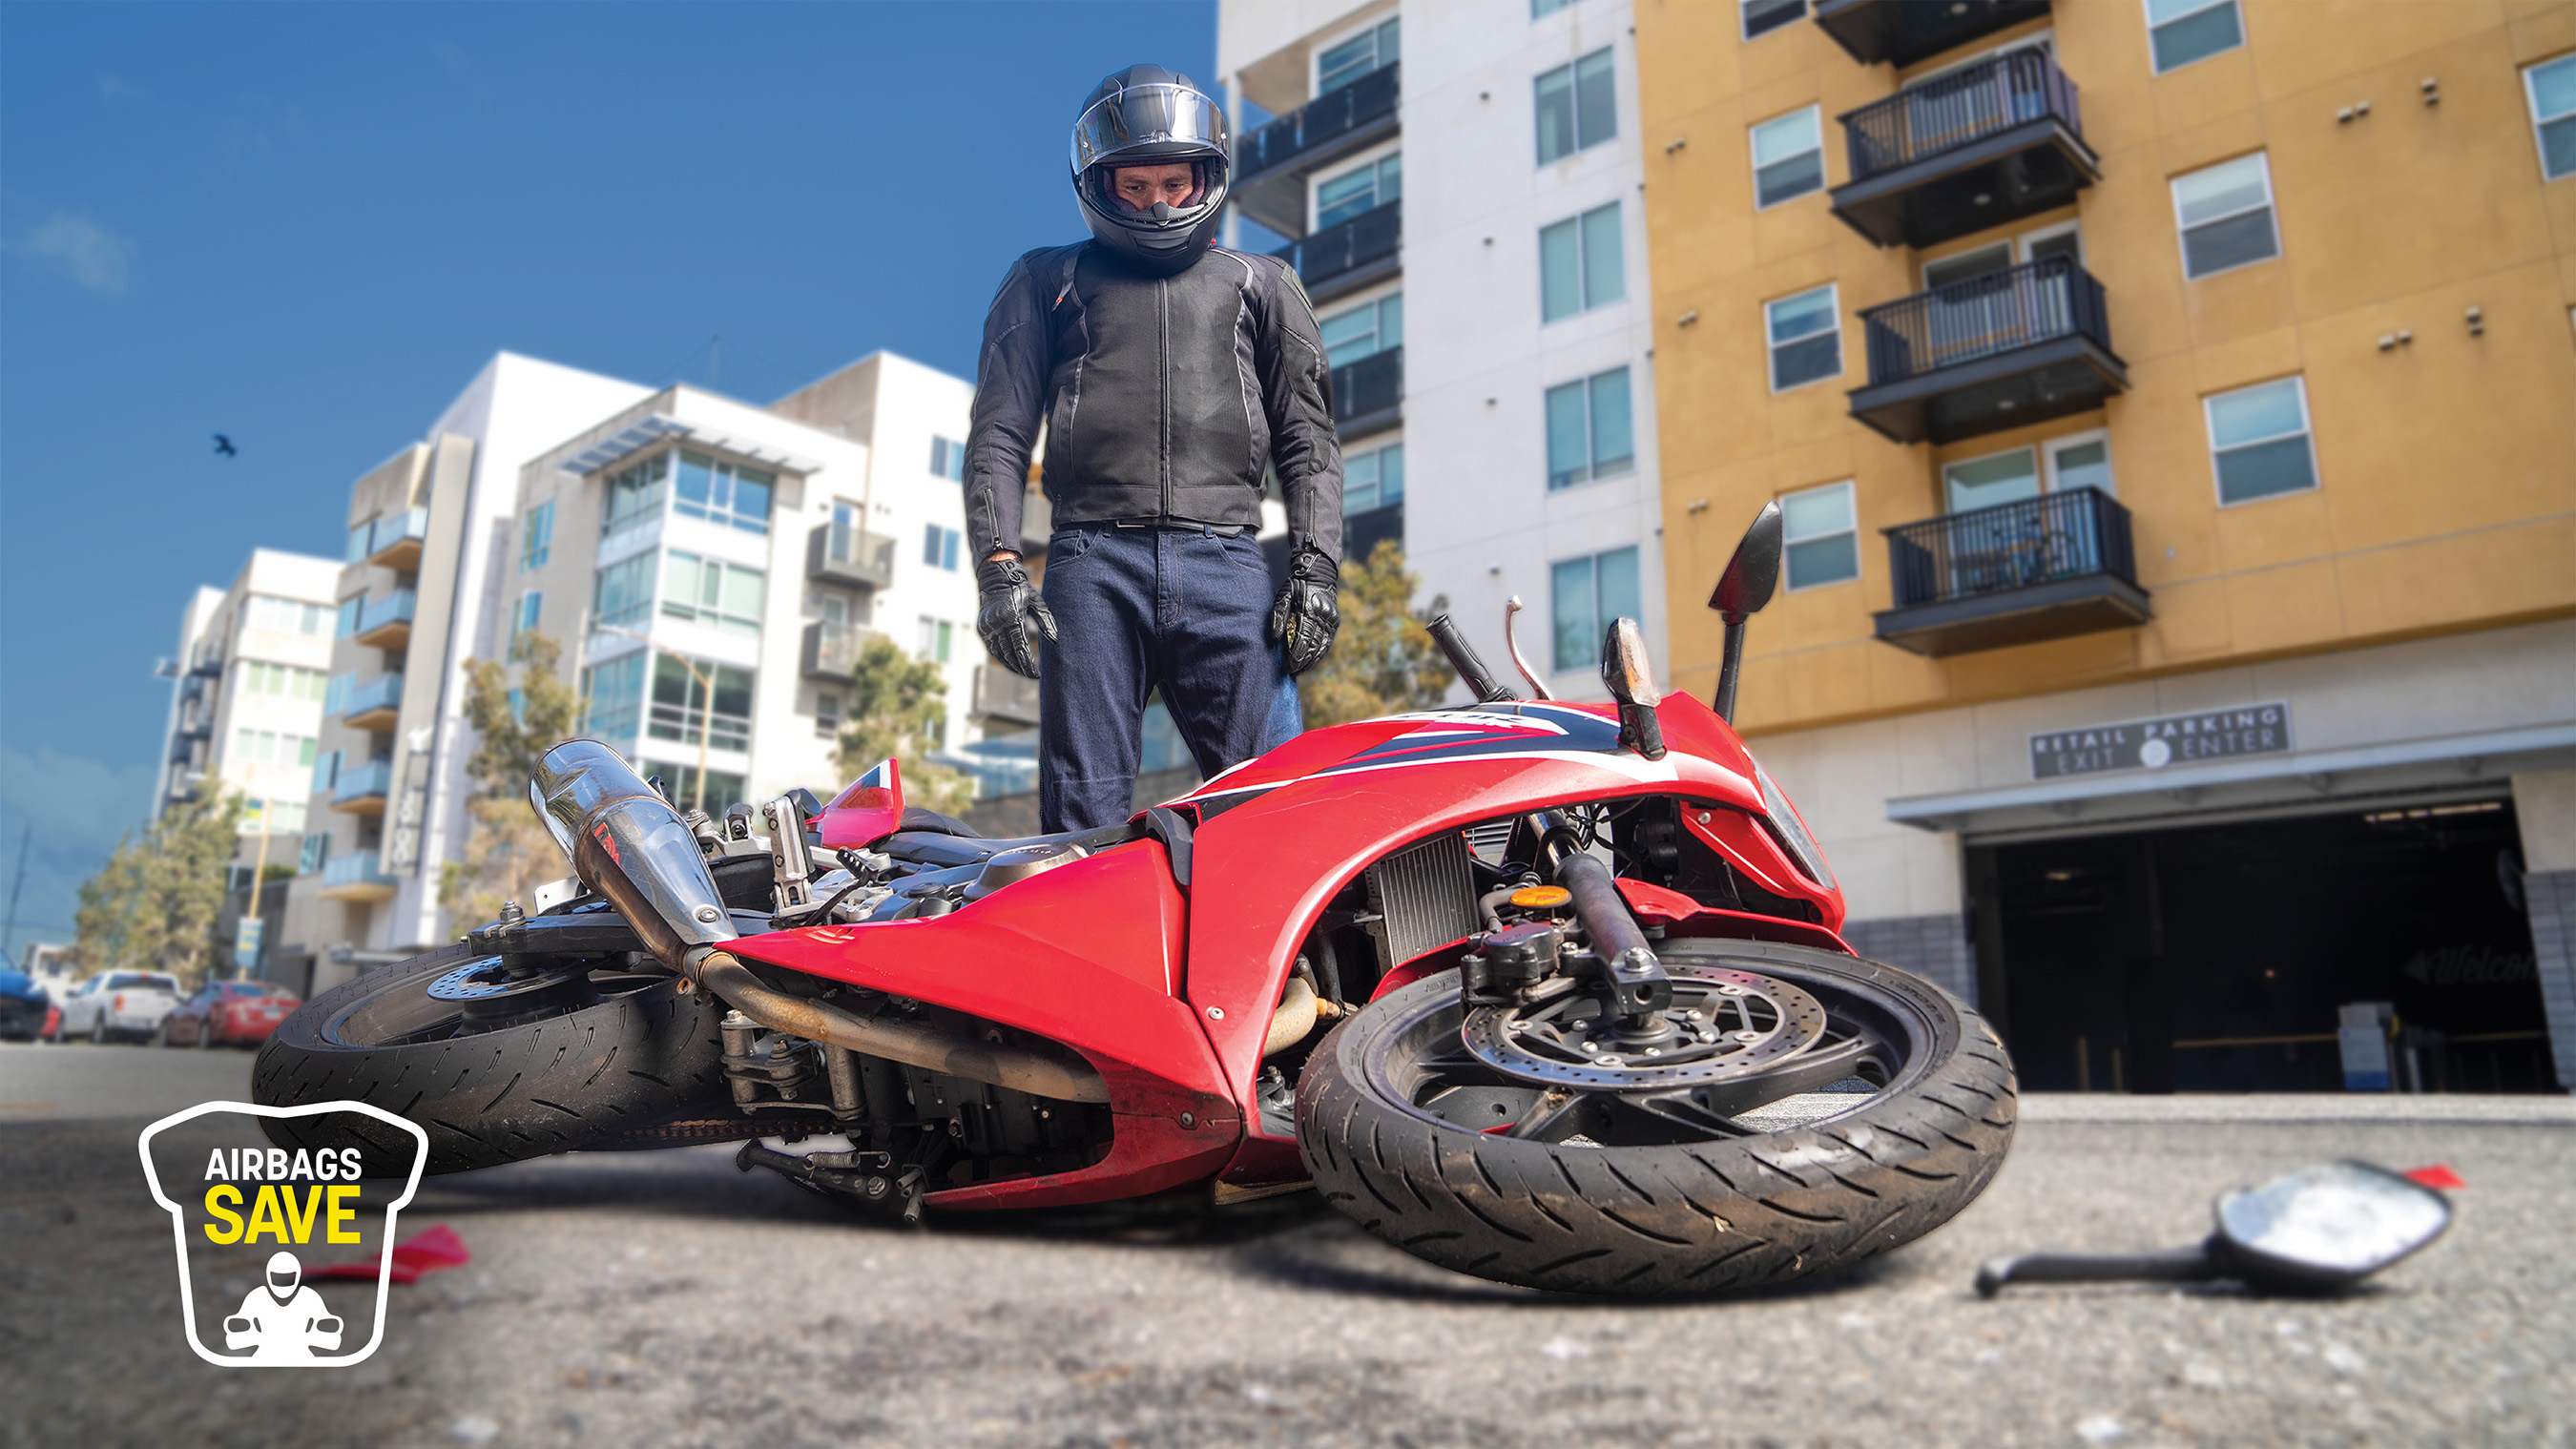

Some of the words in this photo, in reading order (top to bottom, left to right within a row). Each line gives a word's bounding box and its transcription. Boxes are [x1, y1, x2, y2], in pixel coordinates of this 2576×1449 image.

[2034, 730, 2126, 754] RETAIL
[2145, 709, 2278, 738] PARKING
[2057, 749, 2115, 774] EXIT
[2183, 728, 2275, 758] ENTER
